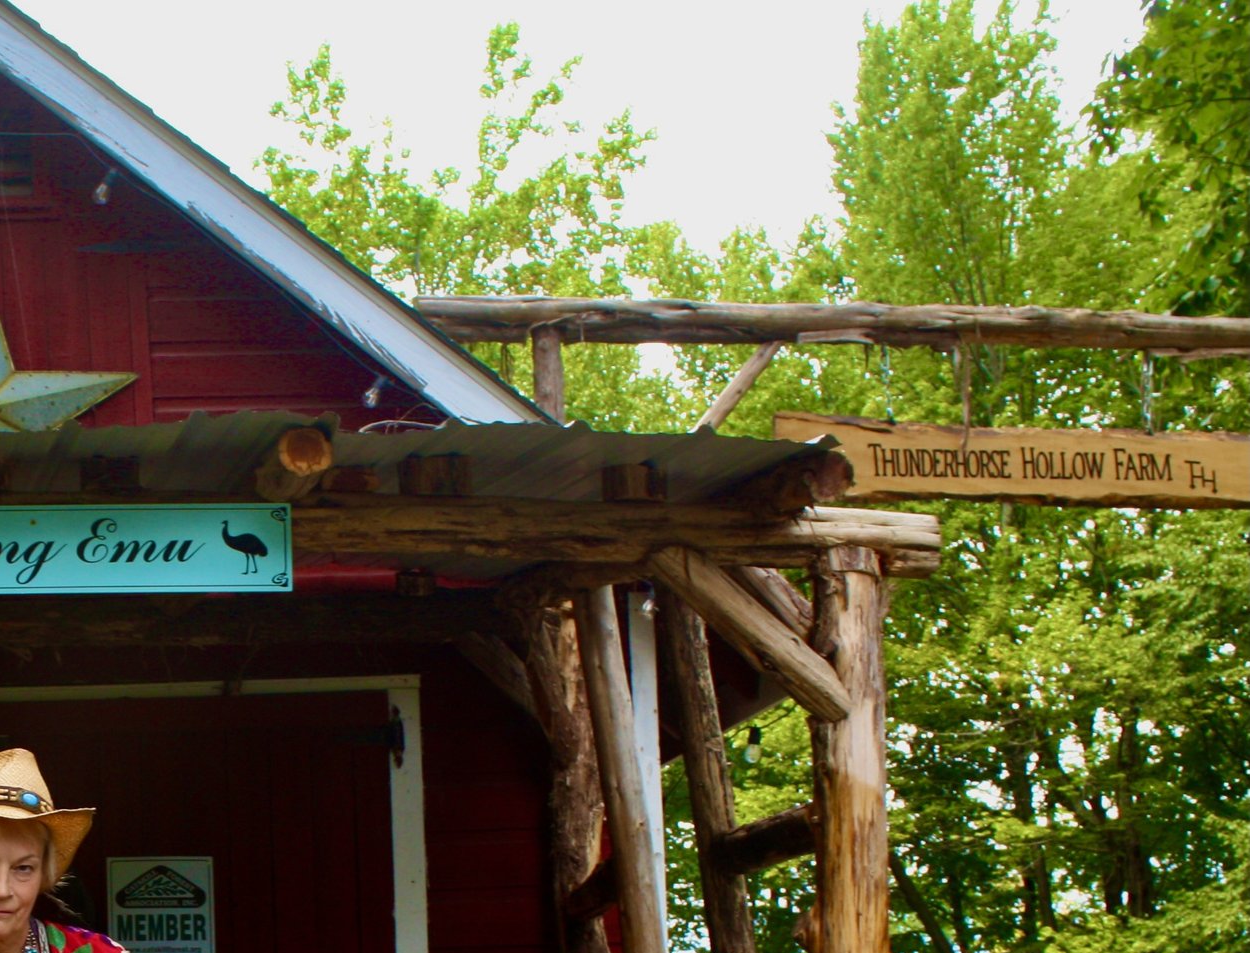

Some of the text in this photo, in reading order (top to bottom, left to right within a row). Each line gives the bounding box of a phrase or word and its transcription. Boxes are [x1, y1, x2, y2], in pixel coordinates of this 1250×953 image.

[867, 442, 1012, 479] THUNDERHORSE
[1020, 445, 1106, 480] HOLLOW
[1113, 447, 1174, 483] FARM
[75, 517, 207, 564] Emu
[117, 913, 207, 941] MEMBER
